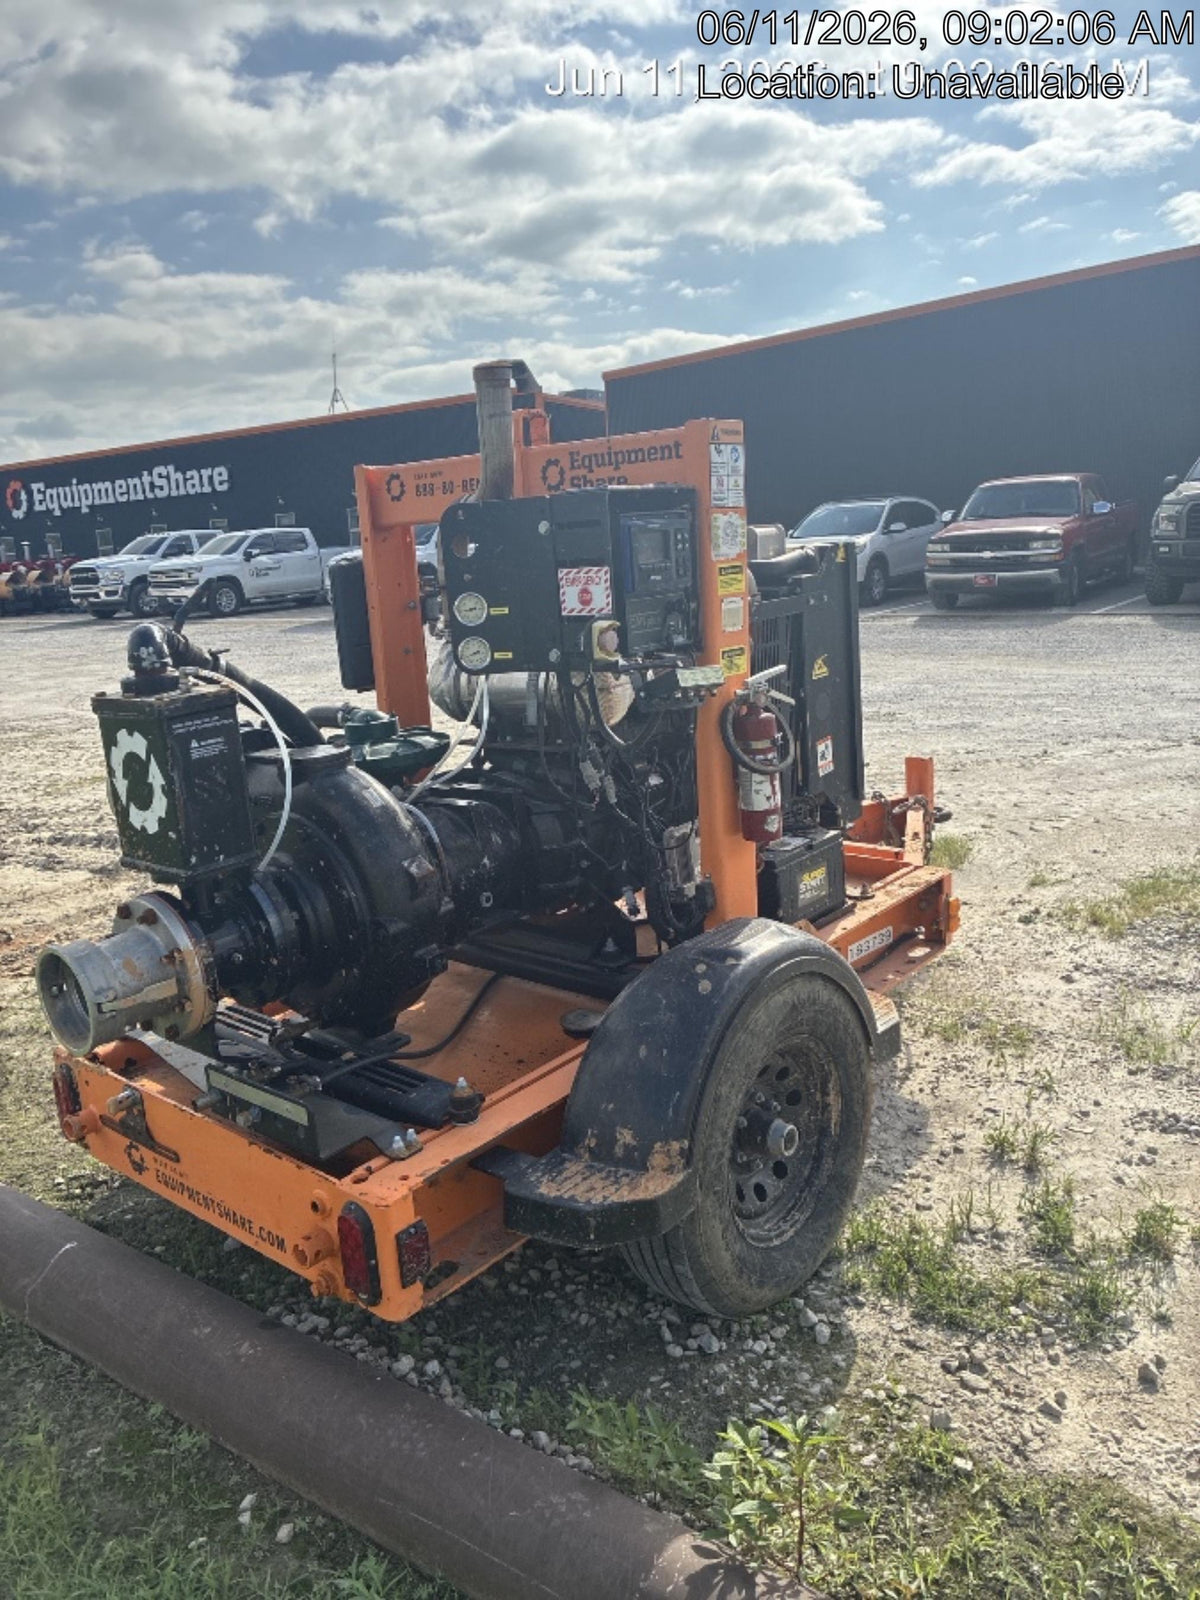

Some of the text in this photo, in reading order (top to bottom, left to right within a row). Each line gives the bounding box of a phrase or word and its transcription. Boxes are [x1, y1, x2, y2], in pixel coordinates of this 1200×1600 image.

[569, 440, 683, 473] Equipment
[30, 464, 229, 516] EquipmentShare
[415, 477, 480, 497] 888-80-REN
